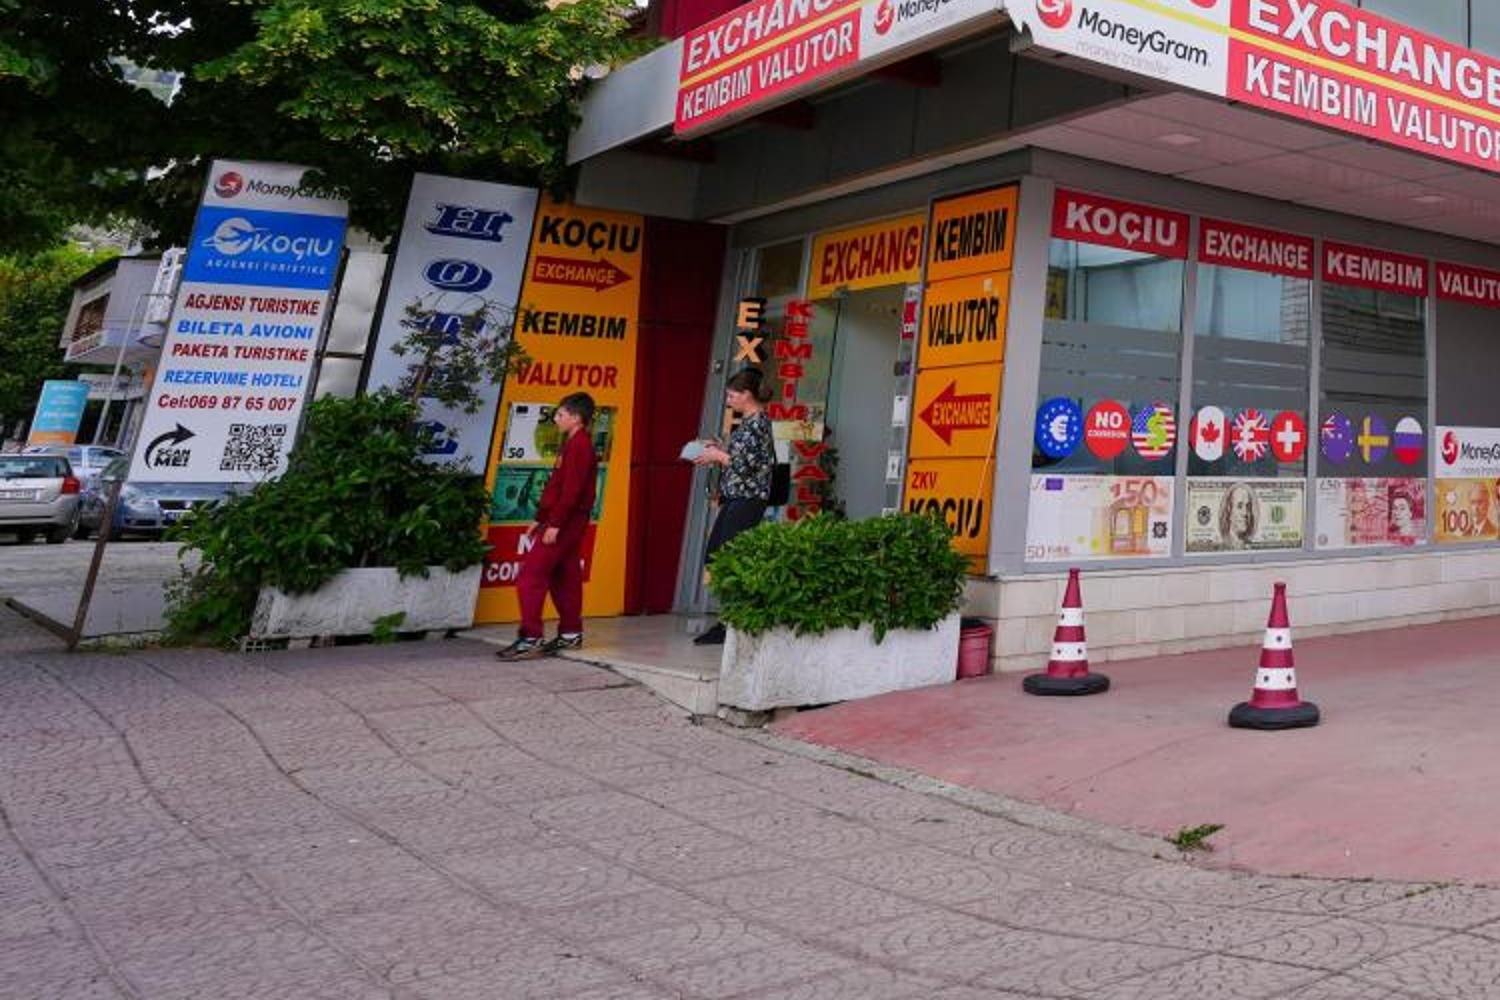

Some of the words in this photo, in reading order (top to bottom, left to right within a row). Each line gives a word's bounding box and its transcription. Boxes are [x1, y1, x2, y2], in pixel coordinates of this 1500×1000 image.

[1077, 7, 1209, 67] MoneyGram
[682, 66, 752, 121] KEMBIM
[758, 20, 854, 89] VALUTOR
[1246, 54, 1377, 127] KEMBIM
[539, 215, 640, 254] KOÇIU
[933, 208, 1008, 263] KEMBIM
[1065, 201, 1178, 247] KOÇIU
[253, 230, 333, 260] KOÇIU
[820, 222, 924, 285] EXCHANG
[1205, 230, 1309, 270] EXCHANGE
[535, 263, 616, 285] EXCHANGE
[1327, 250, 1423, 289] KEMBIM
[185, 294, 244, 311] AGJENSI
[250, 297, 321, 315] TURISTIKE
[177, 320, 244, 337] BILETA
[250, 323, 314, 340] AVIONI
[522, 310, 627, 340] KEMBIM
[927, 297, 1000, 346] VALUTOR
[172, 343, 229, 358] PAKETA
[235, 346, 309, 361] TURISTIKE
[164, 370, 247, 386] REZERVIME
[252, 374, 303, 388] HOTELI
[516, 360, 618, 388] VALUTOR
[158, 394, 217, 409] Cel:069
[222, 396, 242, 410] 87
[245, 396, 264, 411] 65
[268, 398, 298, 411] 007
[931, 401, 991, 427] EXCHANGE
[1095, 411, 1122, 428] NO
[153, 455, 191, 467] ME!
[156, 448, 191, 457] SCAN
[508, 447, 525, 459] 50
[1126, 480, 1157, 506] 50
[1441, 509, 1469, 533] 100
